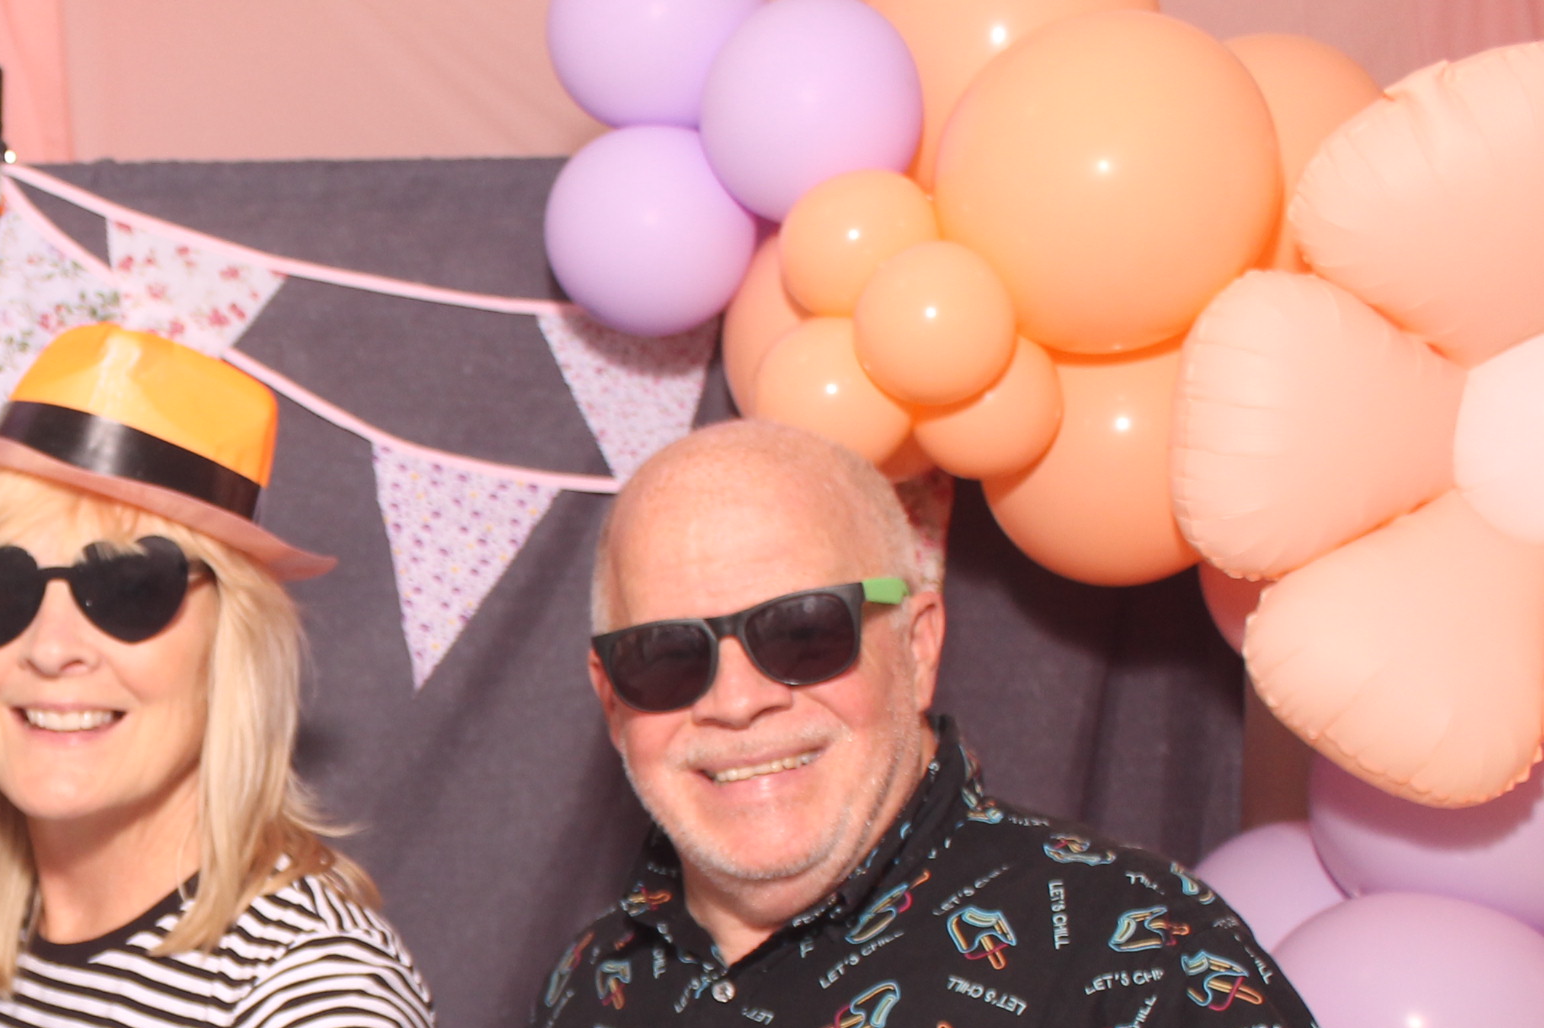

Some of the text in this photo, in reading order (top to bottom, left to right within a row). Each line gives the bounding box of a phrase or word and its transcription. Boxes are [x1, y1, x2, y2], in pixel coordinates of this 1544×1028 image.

[1048, 881, 1070, 950] LET'S CHILL
[819, 954, 860, 989] LET'S
[1084, 972, 1130, 995] LET'S
[947, 976, 1027, 1016] LET'S CHILL
